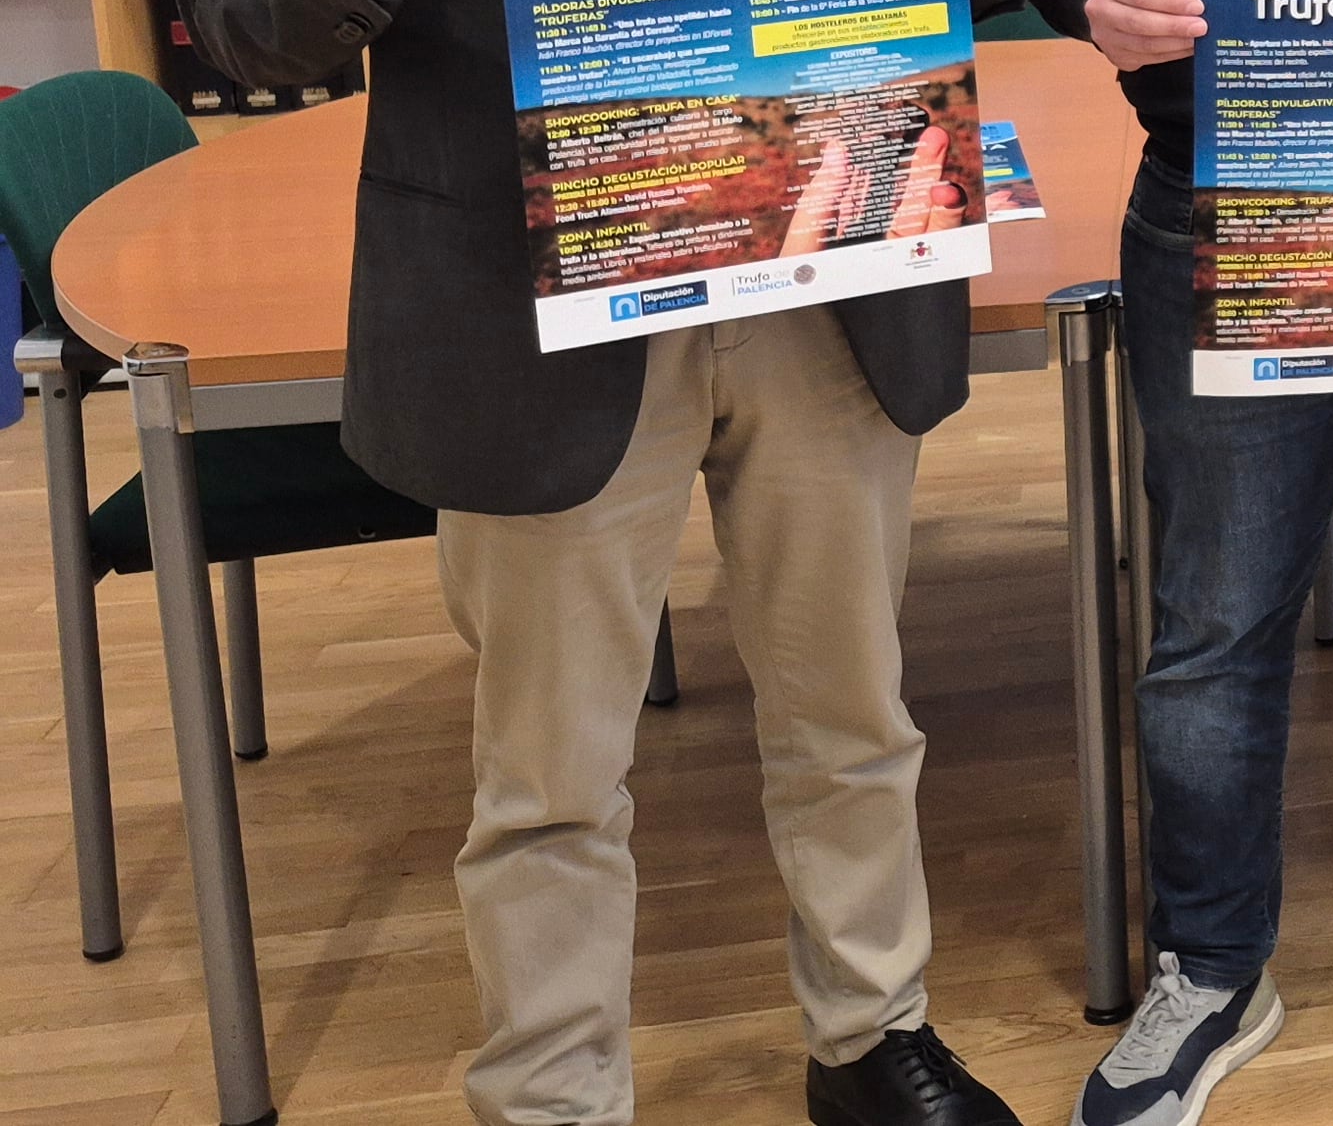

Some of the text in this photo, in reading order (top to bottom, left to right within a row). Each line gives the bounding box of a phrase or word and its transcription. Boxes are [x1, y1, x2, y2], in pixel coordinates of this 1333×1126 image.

[533, 0, 595, 16] PÍLDORAS
[545, 107, 640, 129] SHOWCOOKING:
[686, 98, 704, 109] EN
[552, 155, 745, 193] PINCHO DEGUSTACIÓN POPULAR
[558, 221, 650, 244] ZONA INFANTIL
[737, 273, 770, 285] Trufa
[737, 279, 793, 295] PALENCIA
[643, 286, 694, 303] Diputación
[644, 295, 706, 312] DE PALENCIA
